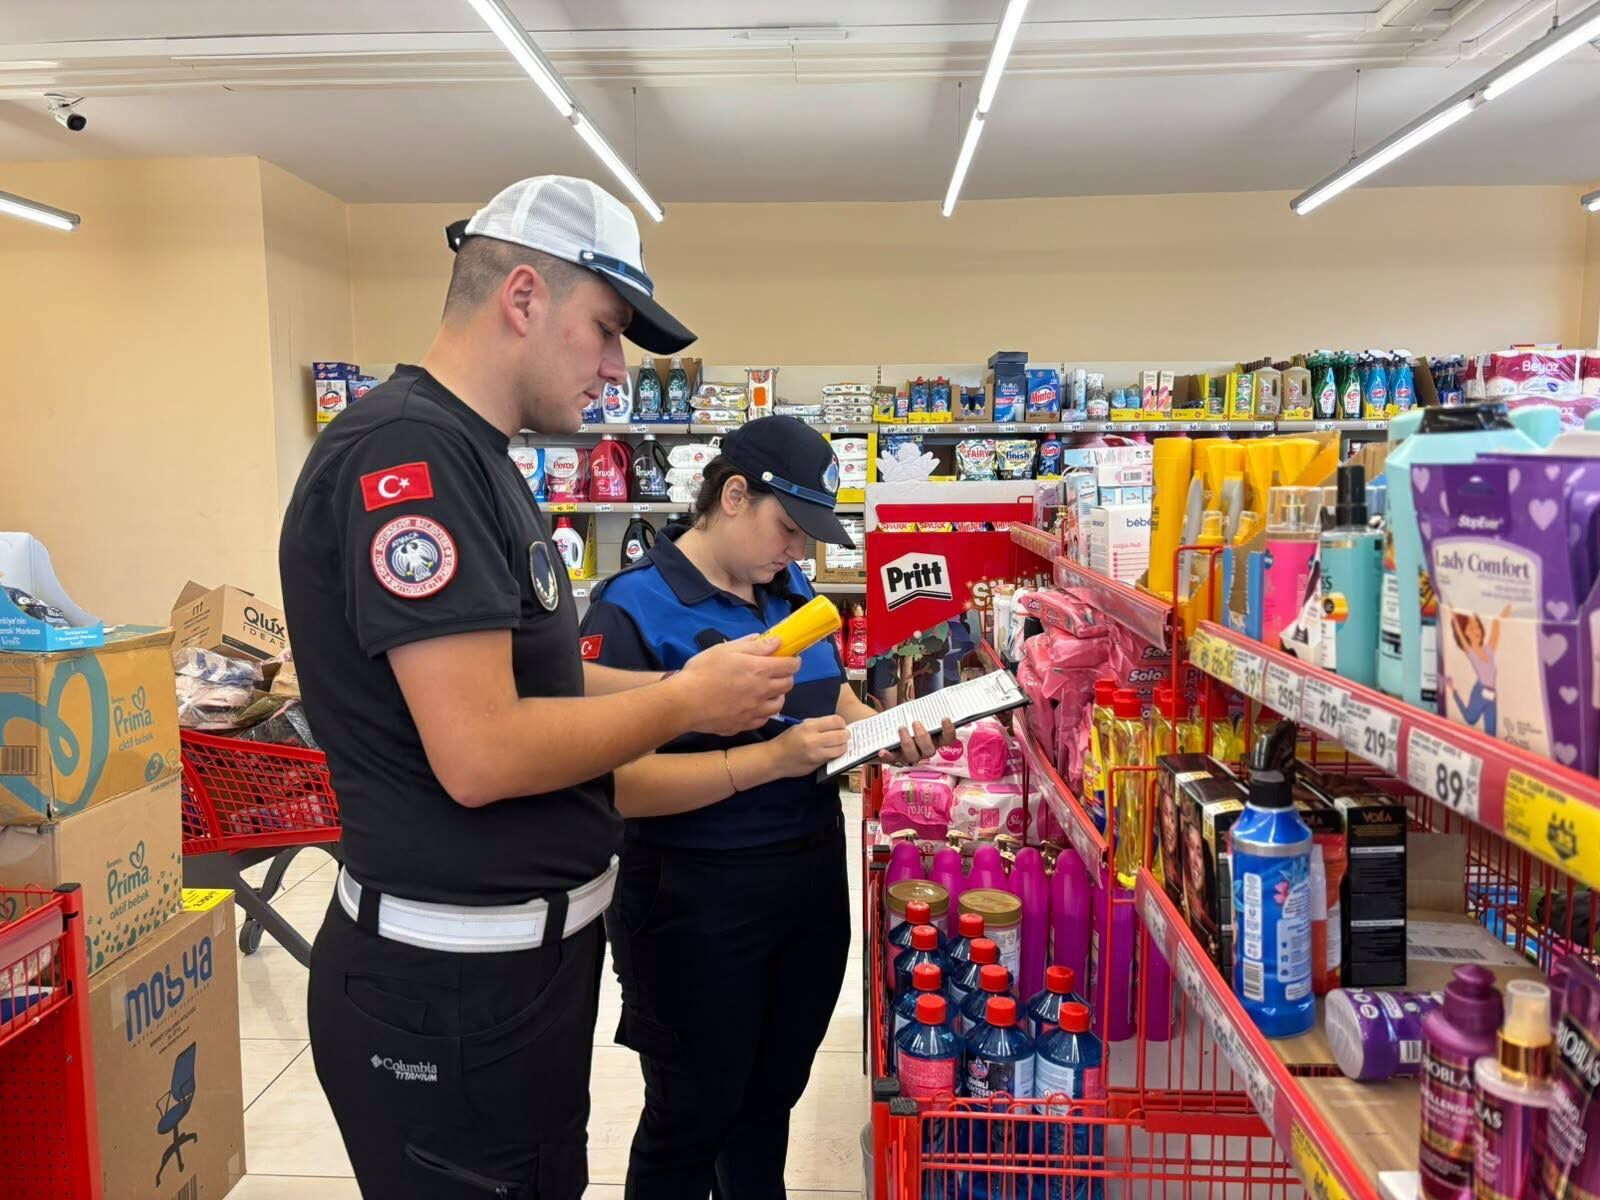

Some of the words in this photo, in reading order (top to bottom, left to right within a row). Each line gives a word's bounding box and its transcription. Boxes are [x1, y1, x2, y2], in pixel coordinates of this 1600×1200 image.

[967, 450, 989, 458] FAIRY
[1006, 450, 1030, 460] finish
[886, 561, 942, 593] Pritt
[1435, 549, 1467, 573] Lady
[1468, 552, 1530, 579] Comfort
[242, 625, 285, 649] IDEAS
[1128, 668, 1163, 682] Solo
[113, 705, 153, 737] Prima
[1319, 699, 1338, 728] 219
[1364, 725, 1387, 758] 219
[1435, 762, 1464, 808] 89
[107, 865, 150, 905] Prima
[383, 1057, 438, 1073] Columbia
[395, 1070, 438, 1082] TITANIUM
